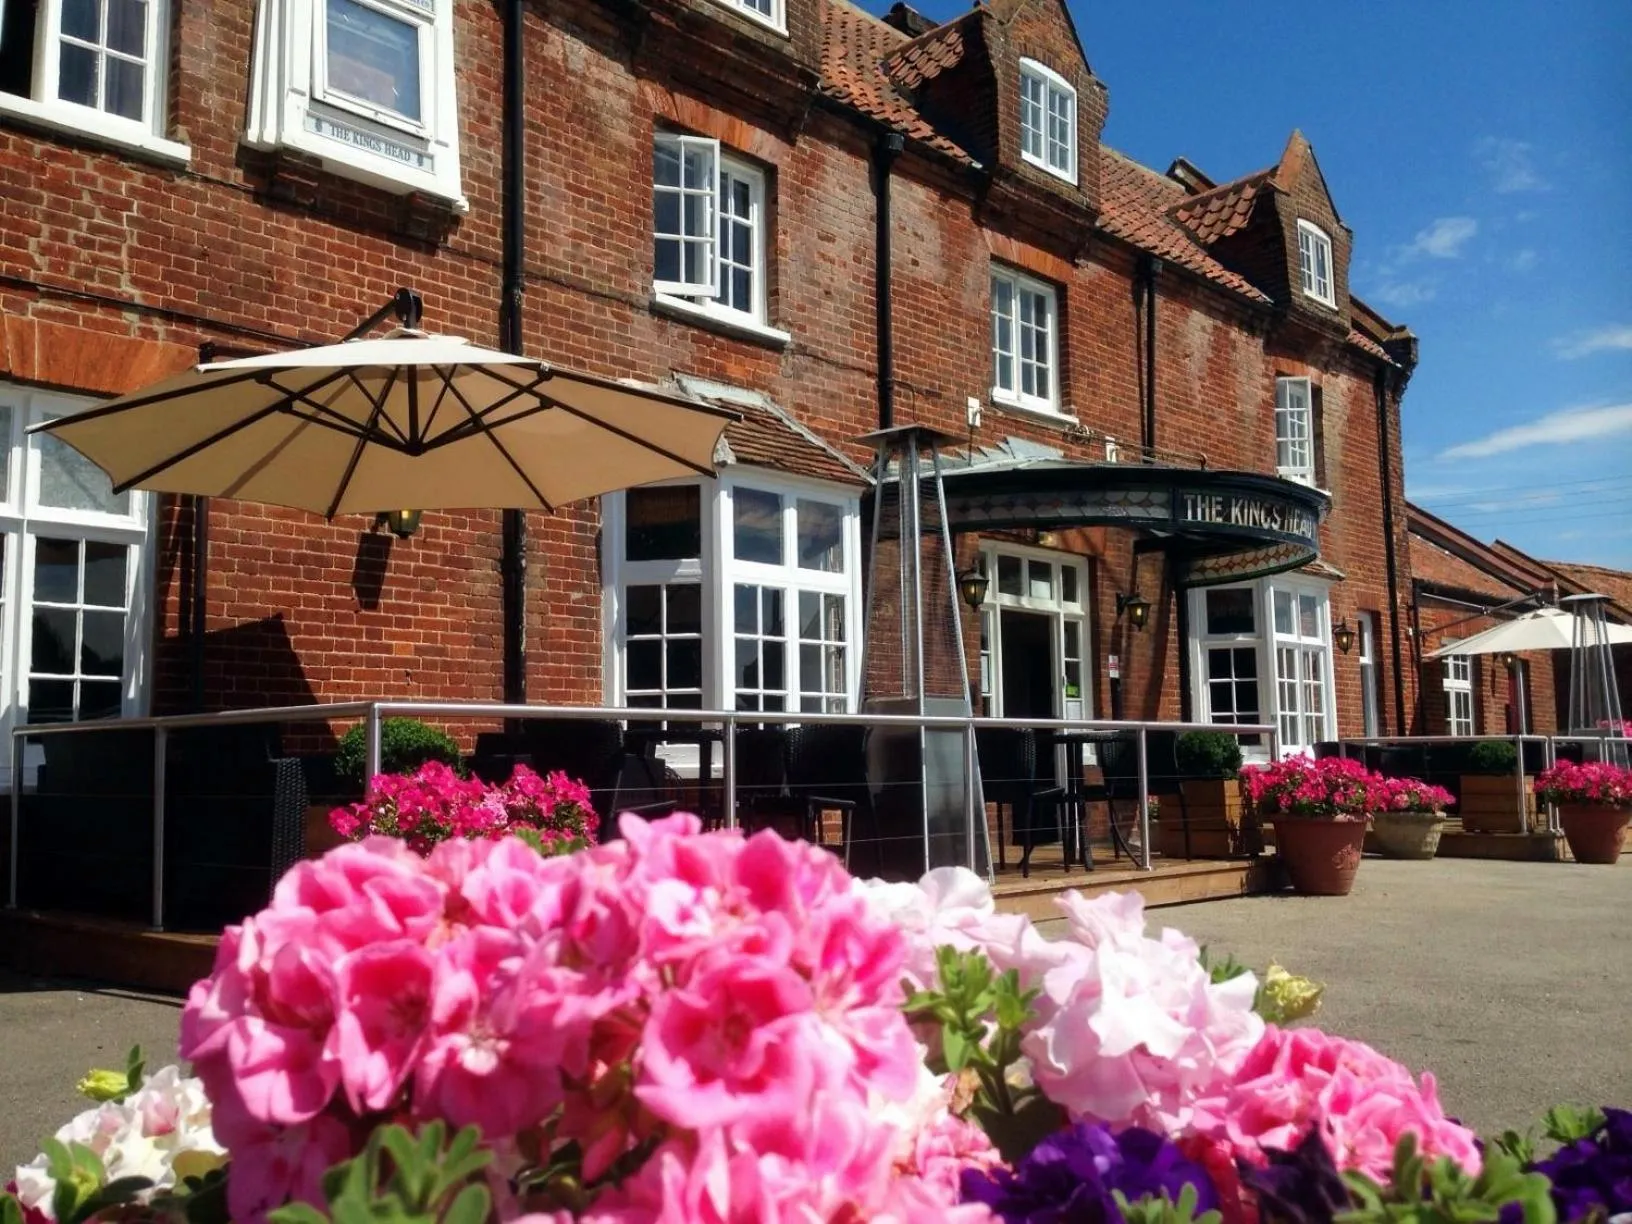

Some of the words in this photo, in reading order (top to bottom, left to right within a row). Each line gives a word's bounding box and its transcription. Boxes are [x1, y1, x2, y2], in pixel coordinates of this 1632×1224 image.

[331, 125, 350, 141] THE
[353, 131, 381, 152] KINGS
[384, 143, 410, 161] HEAD
[1184, 494, 1223, 522] THE
[1231, 497, 1281, 531] KINGS
[1284, 504, 1312, 538] HEAD
